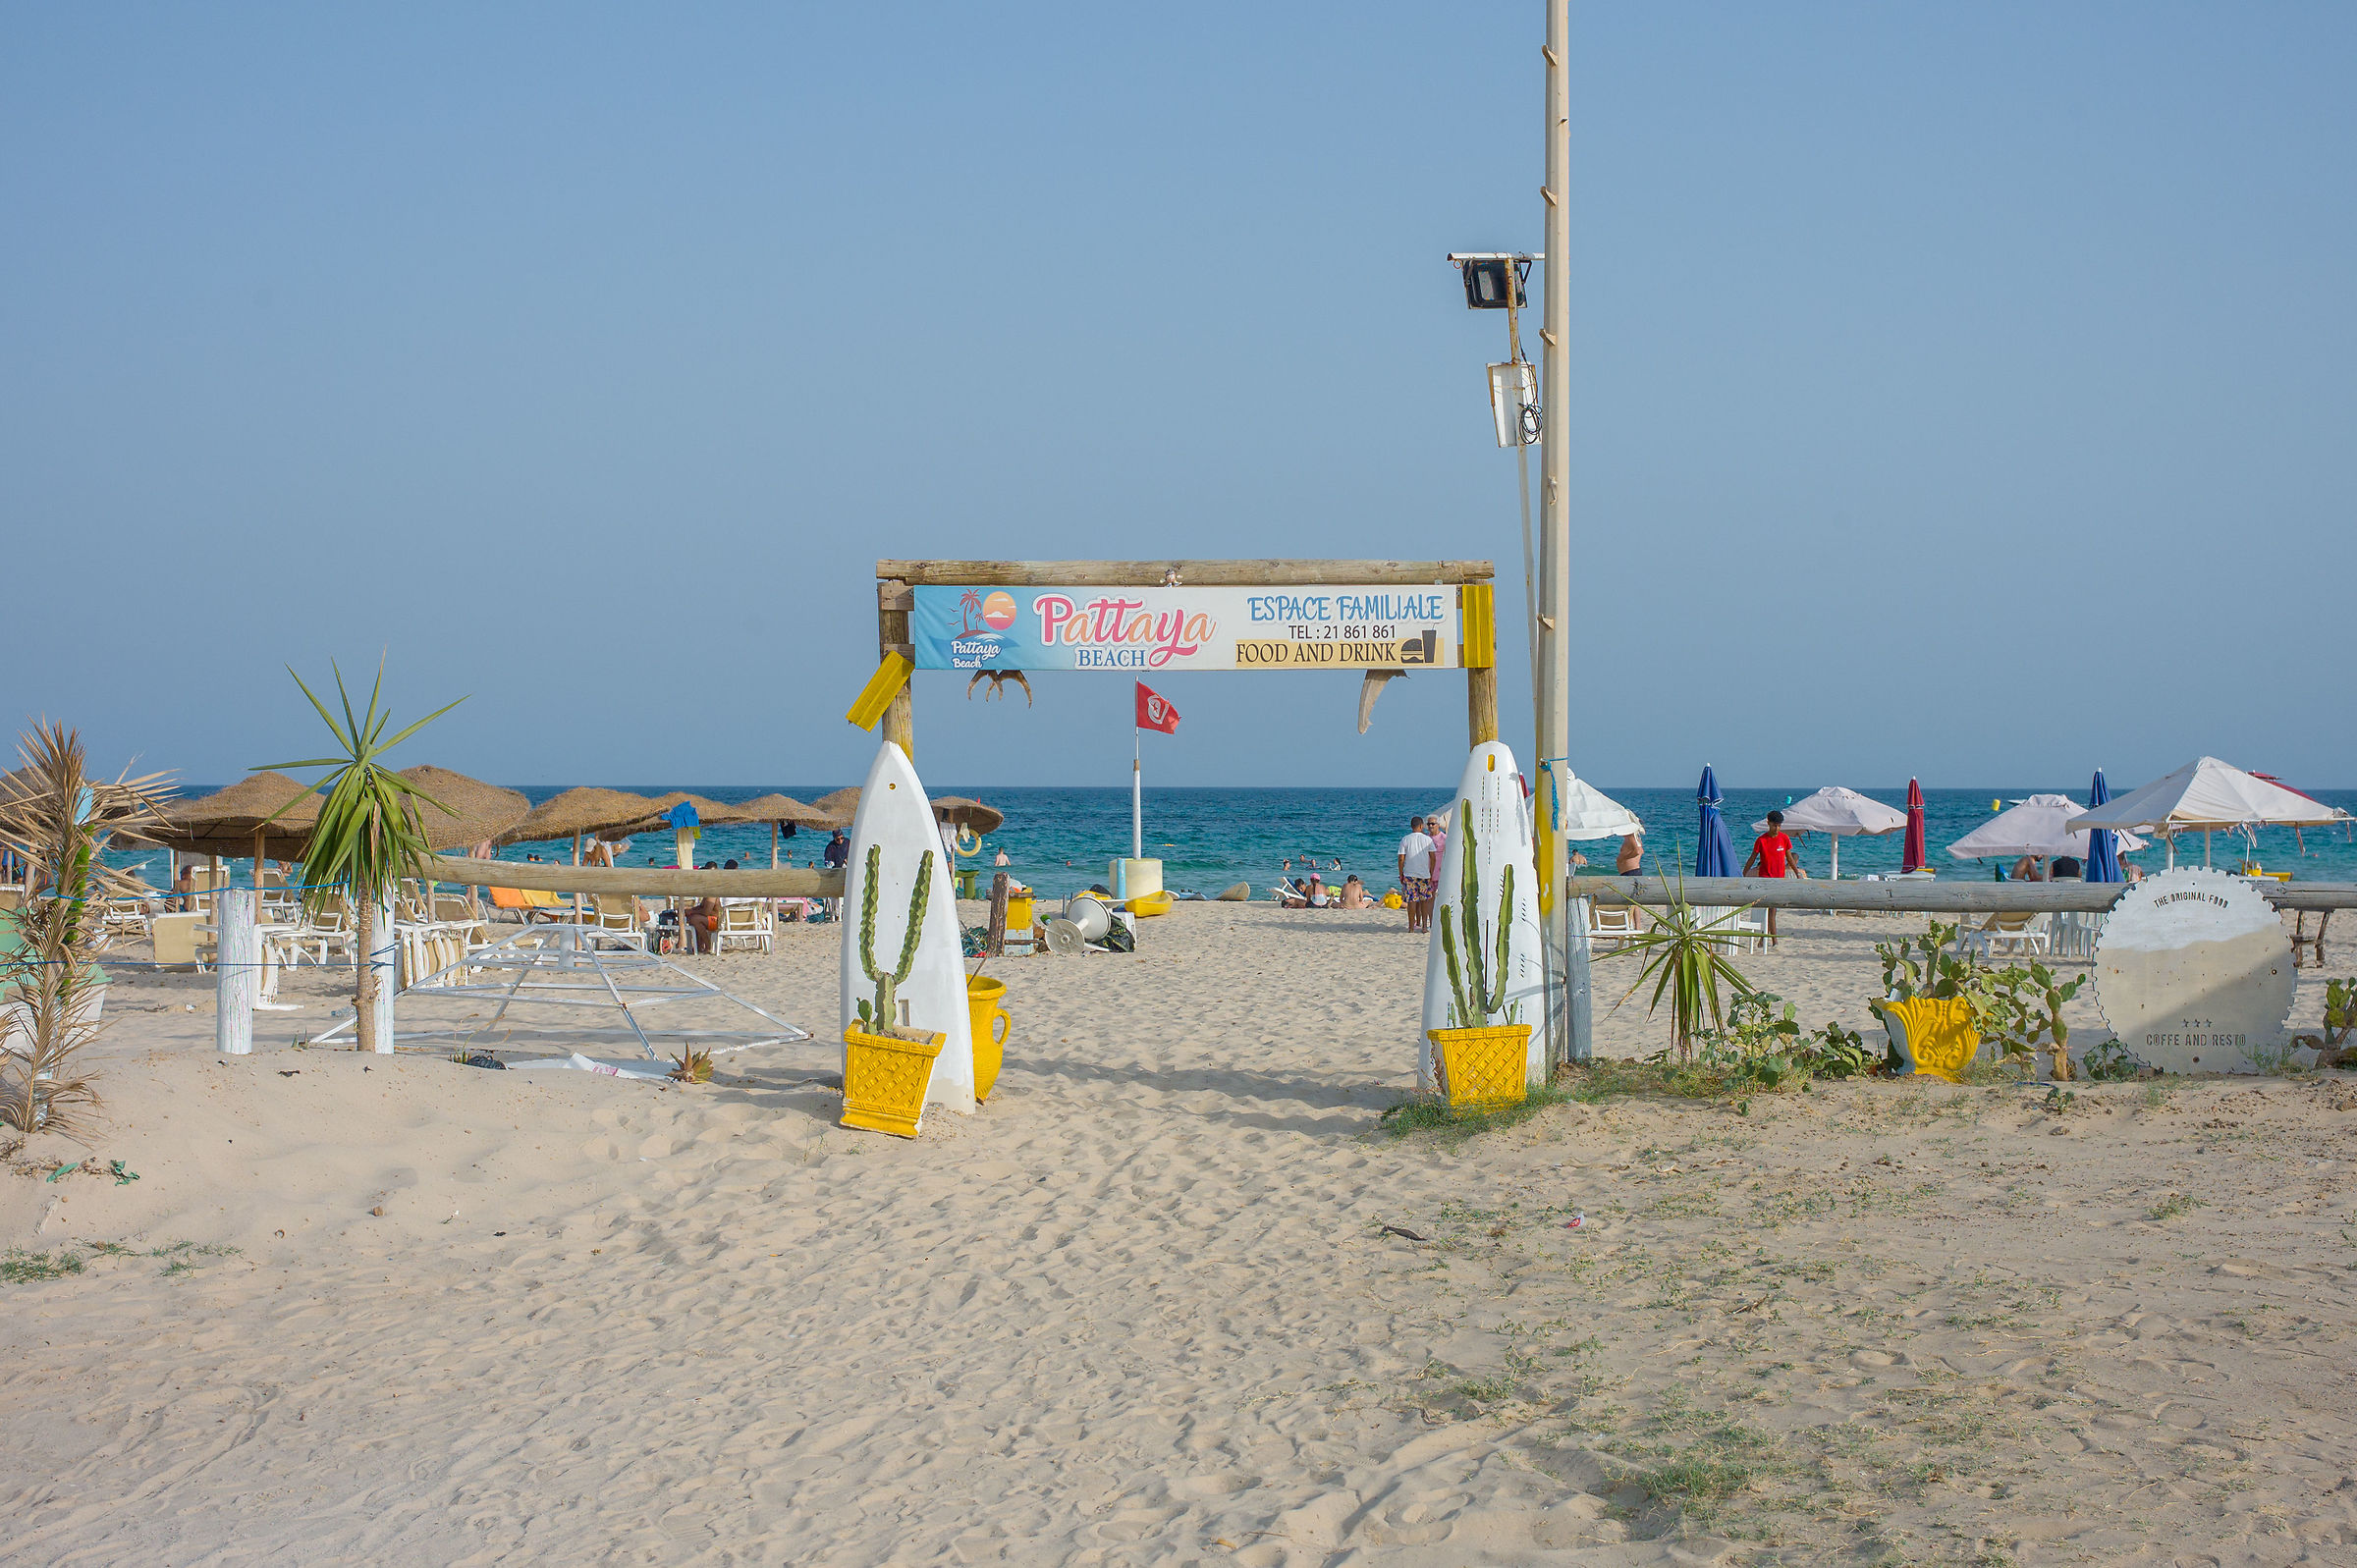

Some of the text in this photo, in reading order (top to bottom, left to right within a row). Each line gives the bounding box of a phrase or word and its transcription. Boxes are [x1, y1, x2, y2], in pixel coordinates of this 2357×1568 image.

[1247, 594, 1444, 622] ESPACE FAMILIALE
[1036, 597, 1216, 668] Pattaya
[1288, 624, 1312, 639] TEL
[1324, 624, 1339, 639] 21
[1343, 624, 1367, 639] 861
[1372, 624, 1396, 639] 861
[952, 640, 1001, 660] Pattaya
[1078, 649, 1146, 667] BEACH
[1236, 642, 1397, 663] FOOD AND DRINK
[952, 657, 983, 669] Beach
[2154, 892, 2228, 908] THE ORIGINAL FOOD
[2146, 1034, 2246, 1046] COFFE AND RESTO
